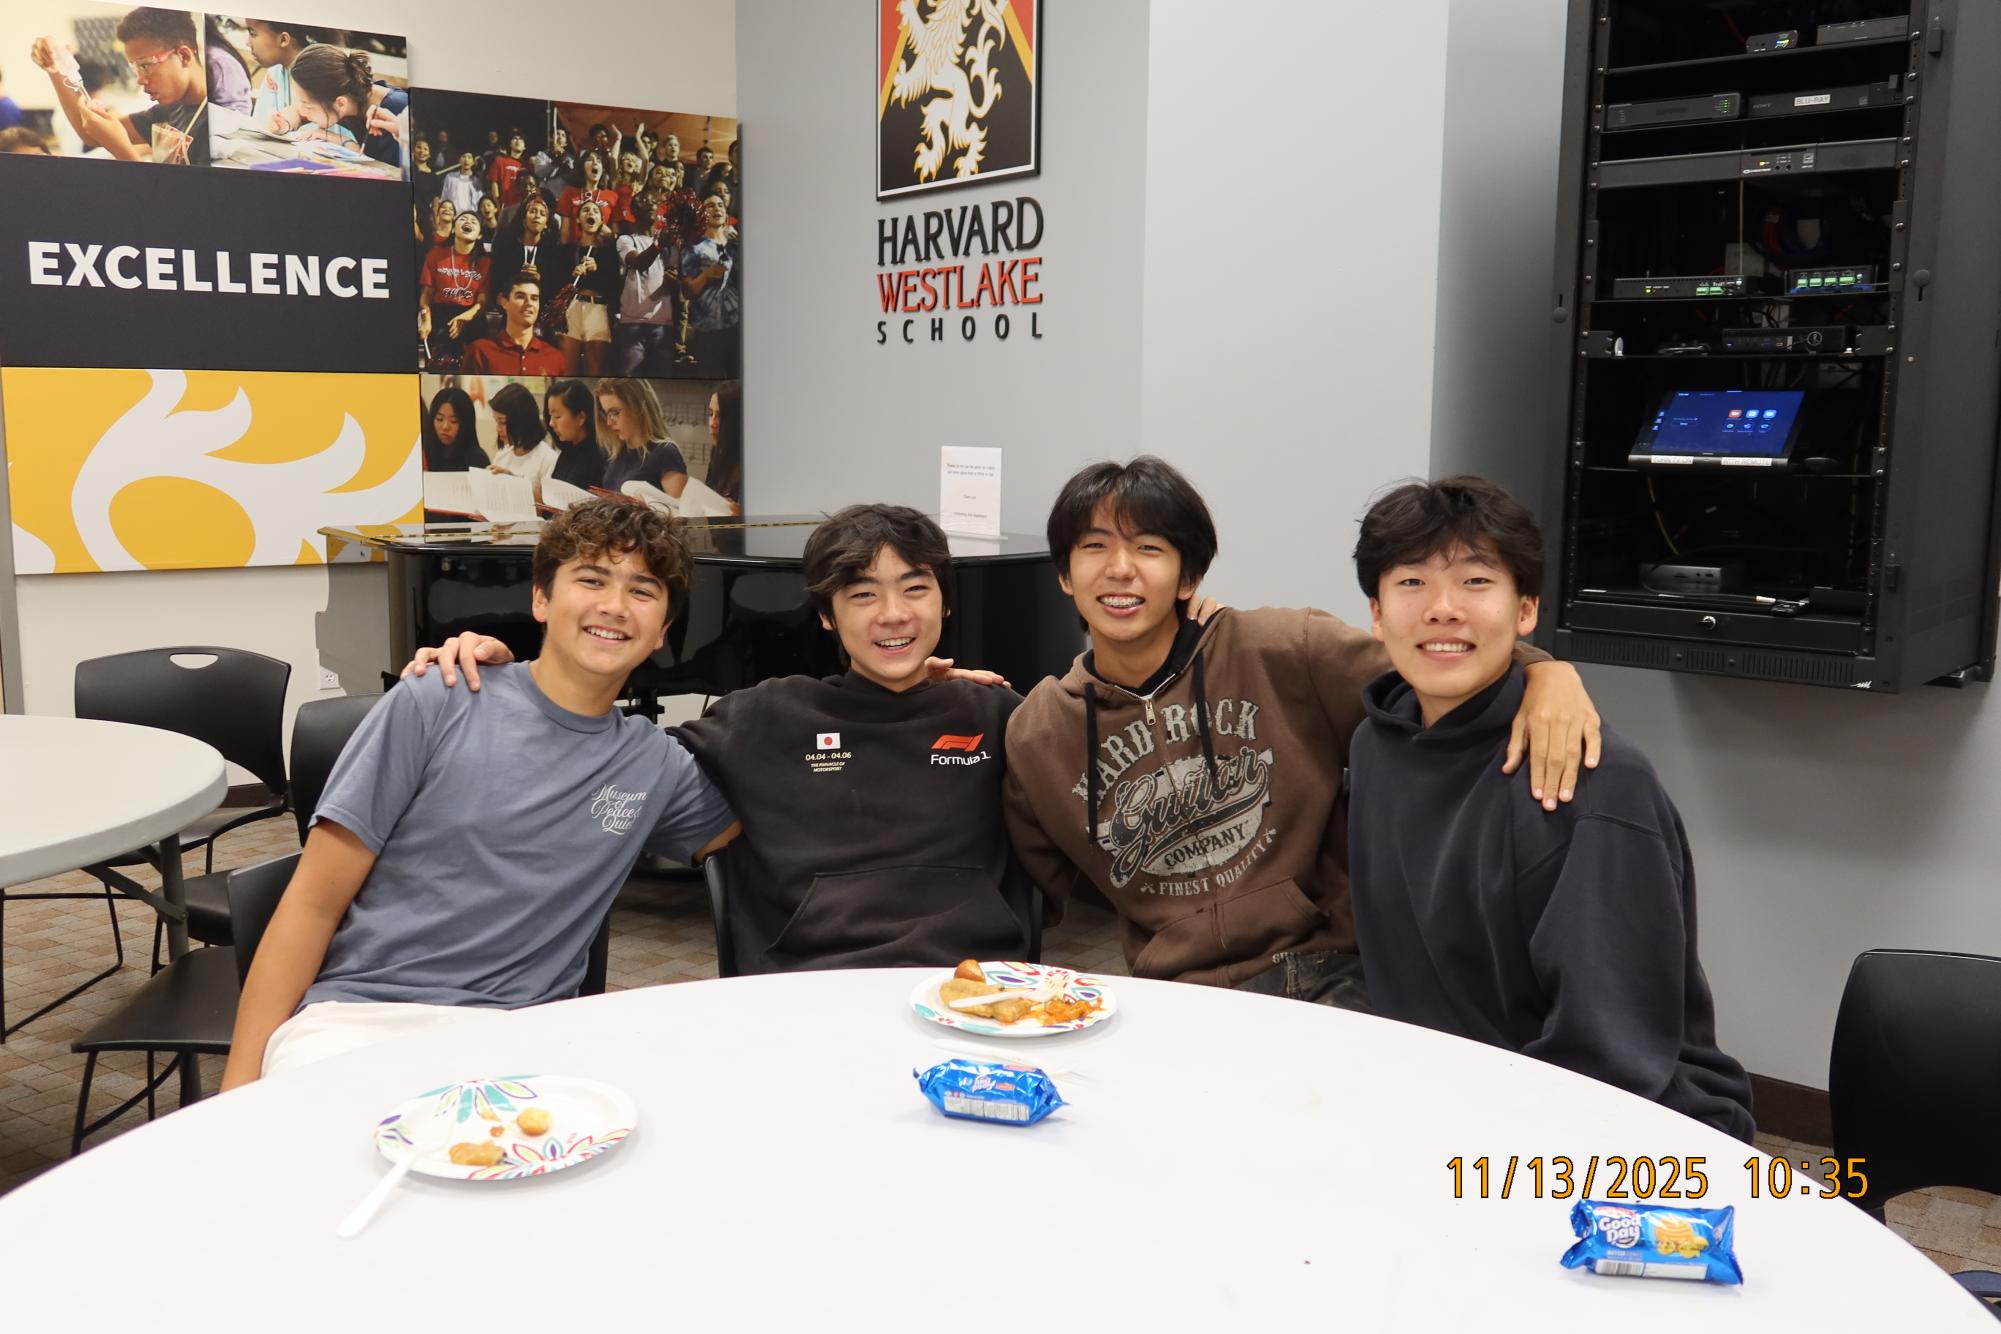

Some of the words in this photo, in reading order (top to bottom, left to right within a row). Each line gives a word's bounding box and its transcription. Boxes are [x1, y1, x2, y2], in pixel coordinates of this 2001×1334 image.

[1796, 95, 1829, 105] BLU-RAY
[877, 197, 1044, 266] HARVARD
[28, 241, 390, 299] EXCELLENCE
[876, 258, 1043, 313] WESTLAKE
[877, 312, 1043, 345] SCHOOL
[805, 753, 826, 761] 04.04
[831, 752, 852, 760] 04.06
[930, 754, 981, 766] Formula
[981, 750, 992, 760] 1
[591, 784, 648, 801] Museum
[591, 800, 636, 819] Peace
[1164, 822, 1248, 868] COMPANY
[1159, 877, 1210, 896] FINEST
[1216, 843, 1267, 888] QUALITY
[1598, 1215, 1641, 1231] Good
[1606, 1226, 1641, 1249] Day
